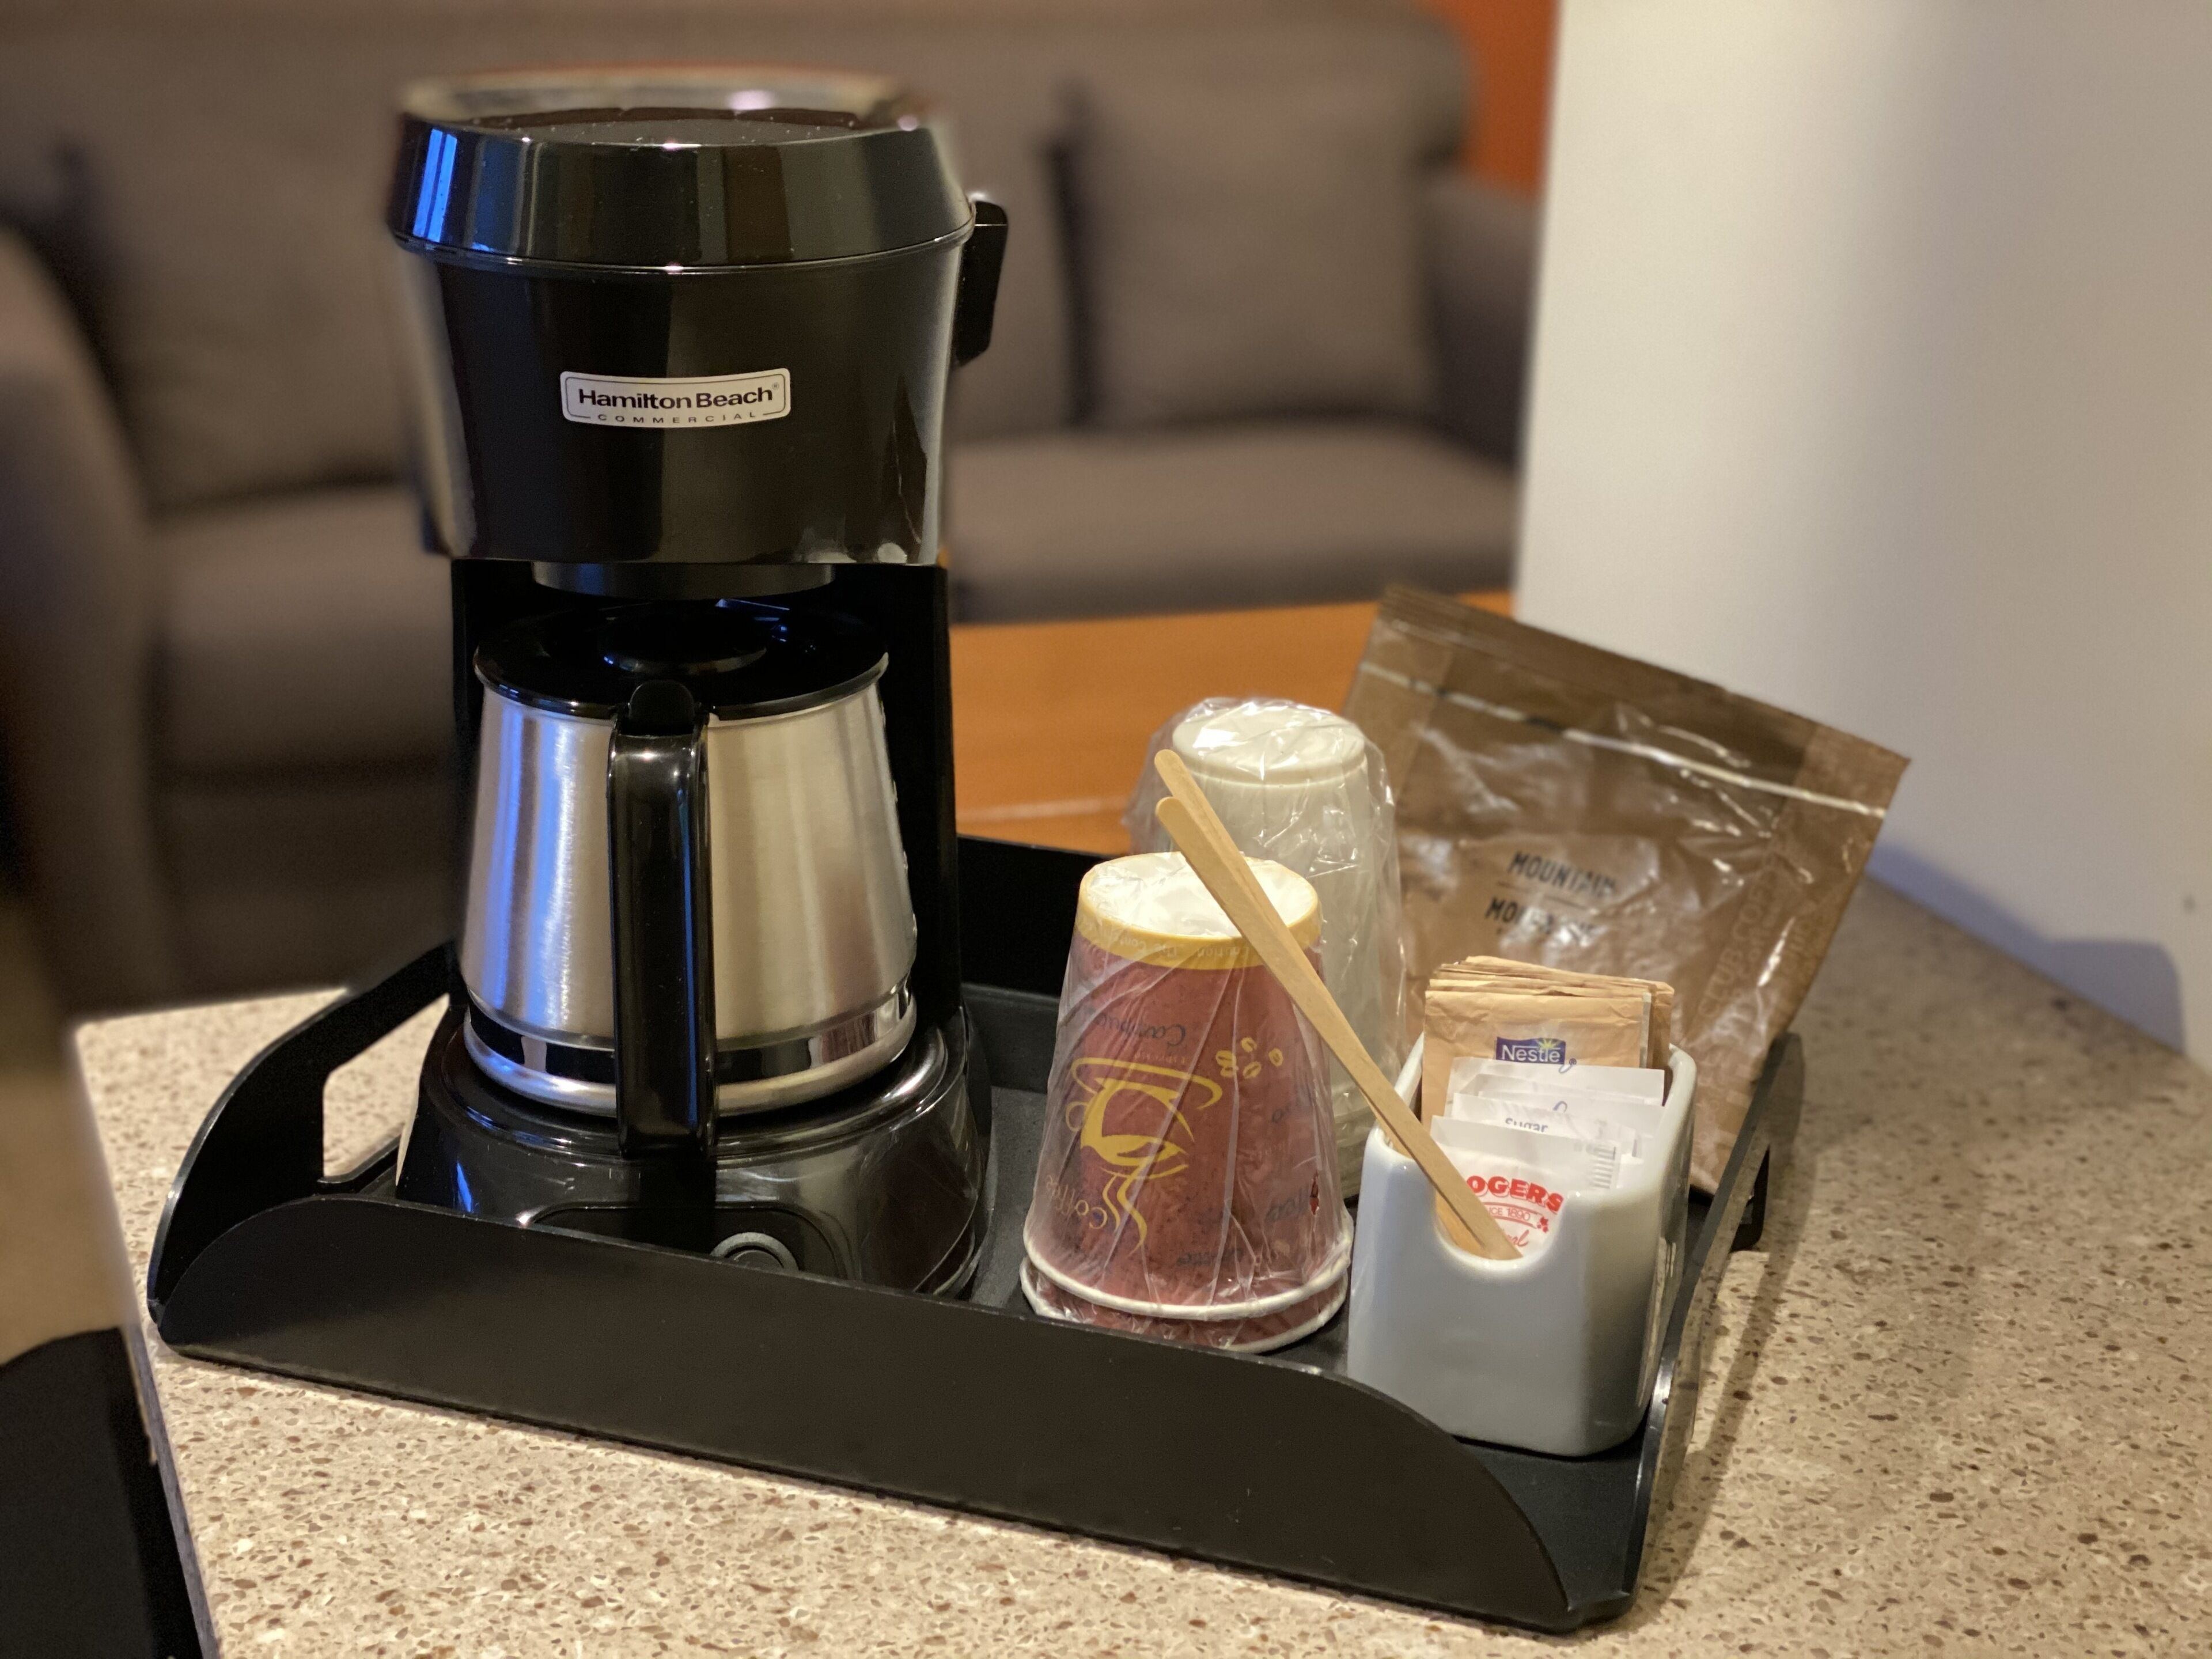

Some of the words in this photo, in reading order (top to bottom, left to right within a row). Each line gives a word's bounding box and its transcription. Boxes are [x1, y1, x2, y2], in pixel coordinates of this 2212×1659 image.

[579, 388, 692, 410] Hamilton
[598, 411, 756, 424] COMMERCIAL
[1466, 1175, 1565, 1215] OGERS
[1507, 1208, 1531, 1221] 1890
